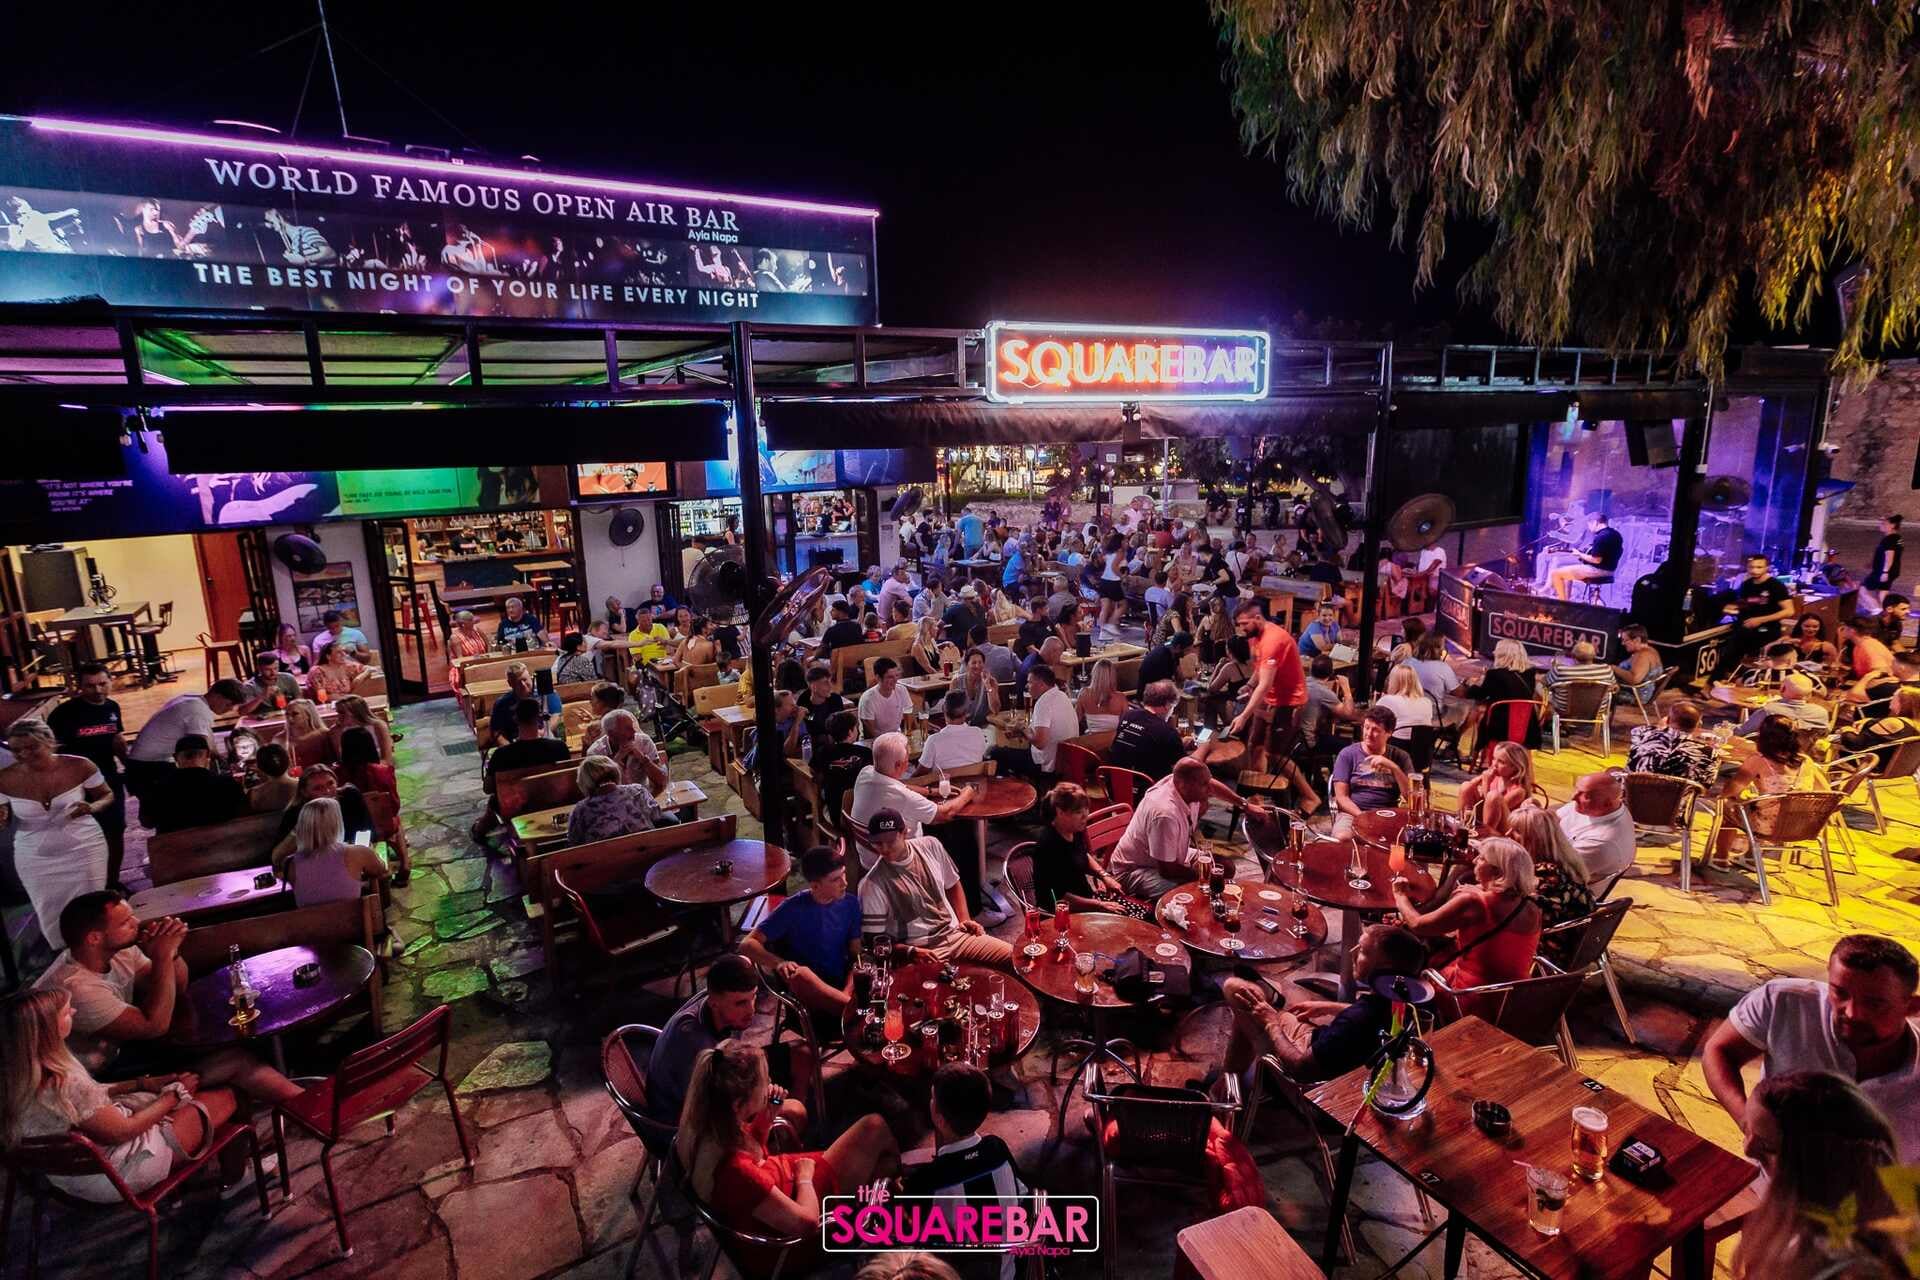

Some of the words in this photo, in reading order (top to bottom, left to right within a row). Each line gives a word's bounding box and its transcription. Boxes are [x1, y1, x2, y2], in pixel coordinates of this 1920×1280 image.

[204, 158, 358, 196] WORLD
[371, 174, 521, 212] FAMOUS
[532, 191, 615, 220] OPEN
[626, 201, 678, 226] AIR
[686, 206, 740, 232] BAR
[711, 231, 738, 244] Napa
[193, 263, 253, 286] THE
[267, 266, 333, 289] BEST
[347, 271, 432, 292] NIGHT
[447, 276, 480, 295] OF
[492, 279, 558, 299] YOUR
[569, 283, 613, 302] LIFE
[624, 286, 688, 305] EVERY
[698, 289, 760, 308] NIGHT
[1001, 339, 1256, 387] SQUAREBAR
